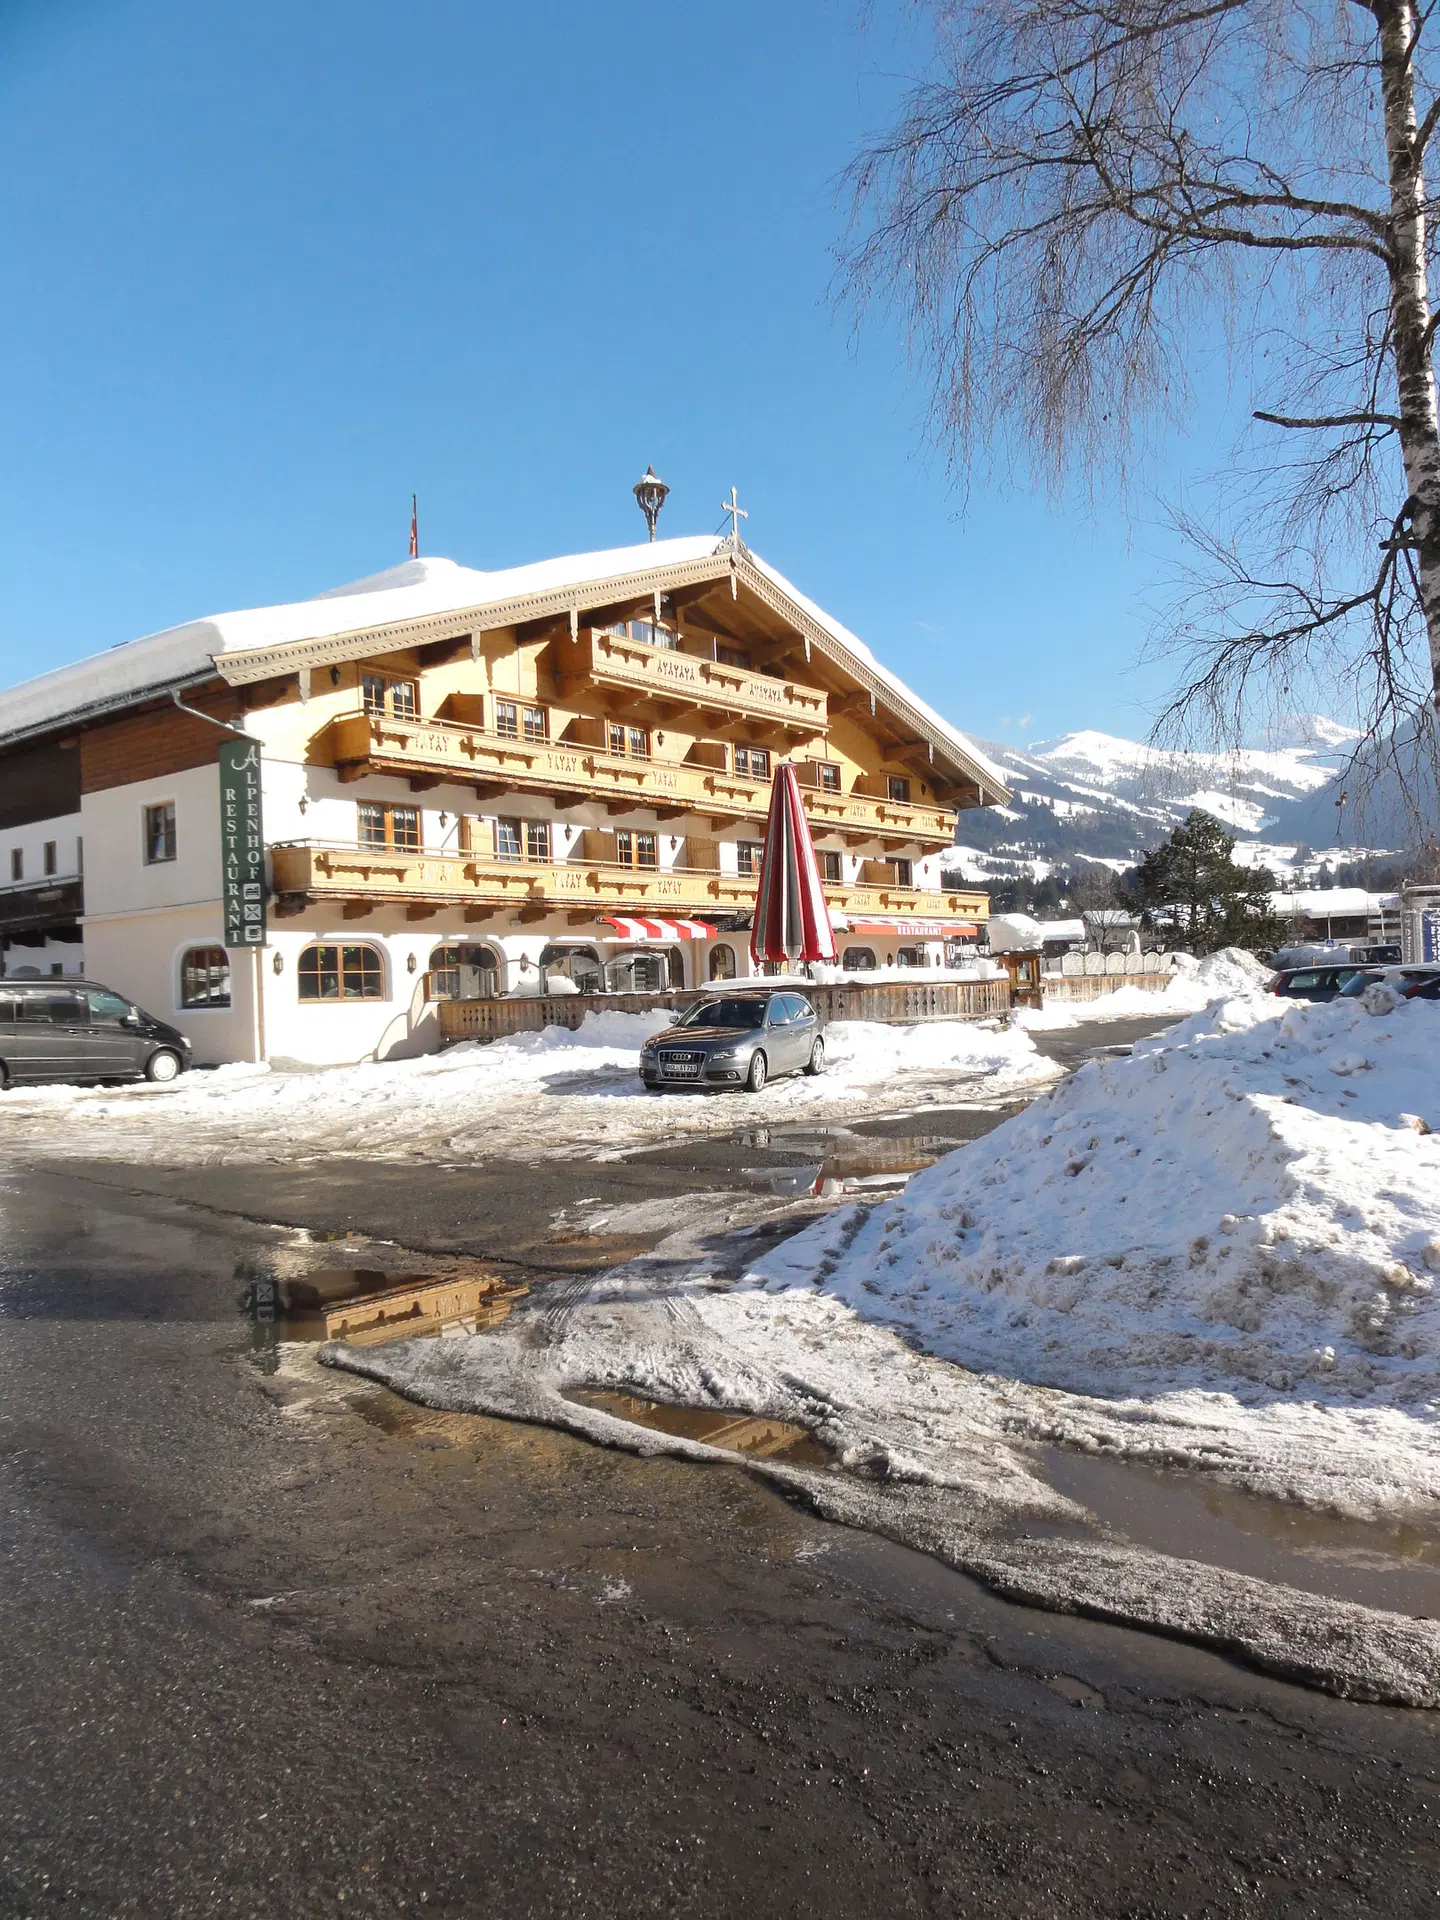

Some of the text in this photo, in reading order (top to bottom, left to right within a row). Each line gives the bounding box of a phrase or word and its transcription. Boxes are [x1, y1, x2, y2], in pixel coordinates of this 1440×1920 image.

[225, 788, 241, 943] RESTAURANT
[230, 745, 260, 880] ALPENHOF
[897, 926, 942, 935] RESTAURANT
